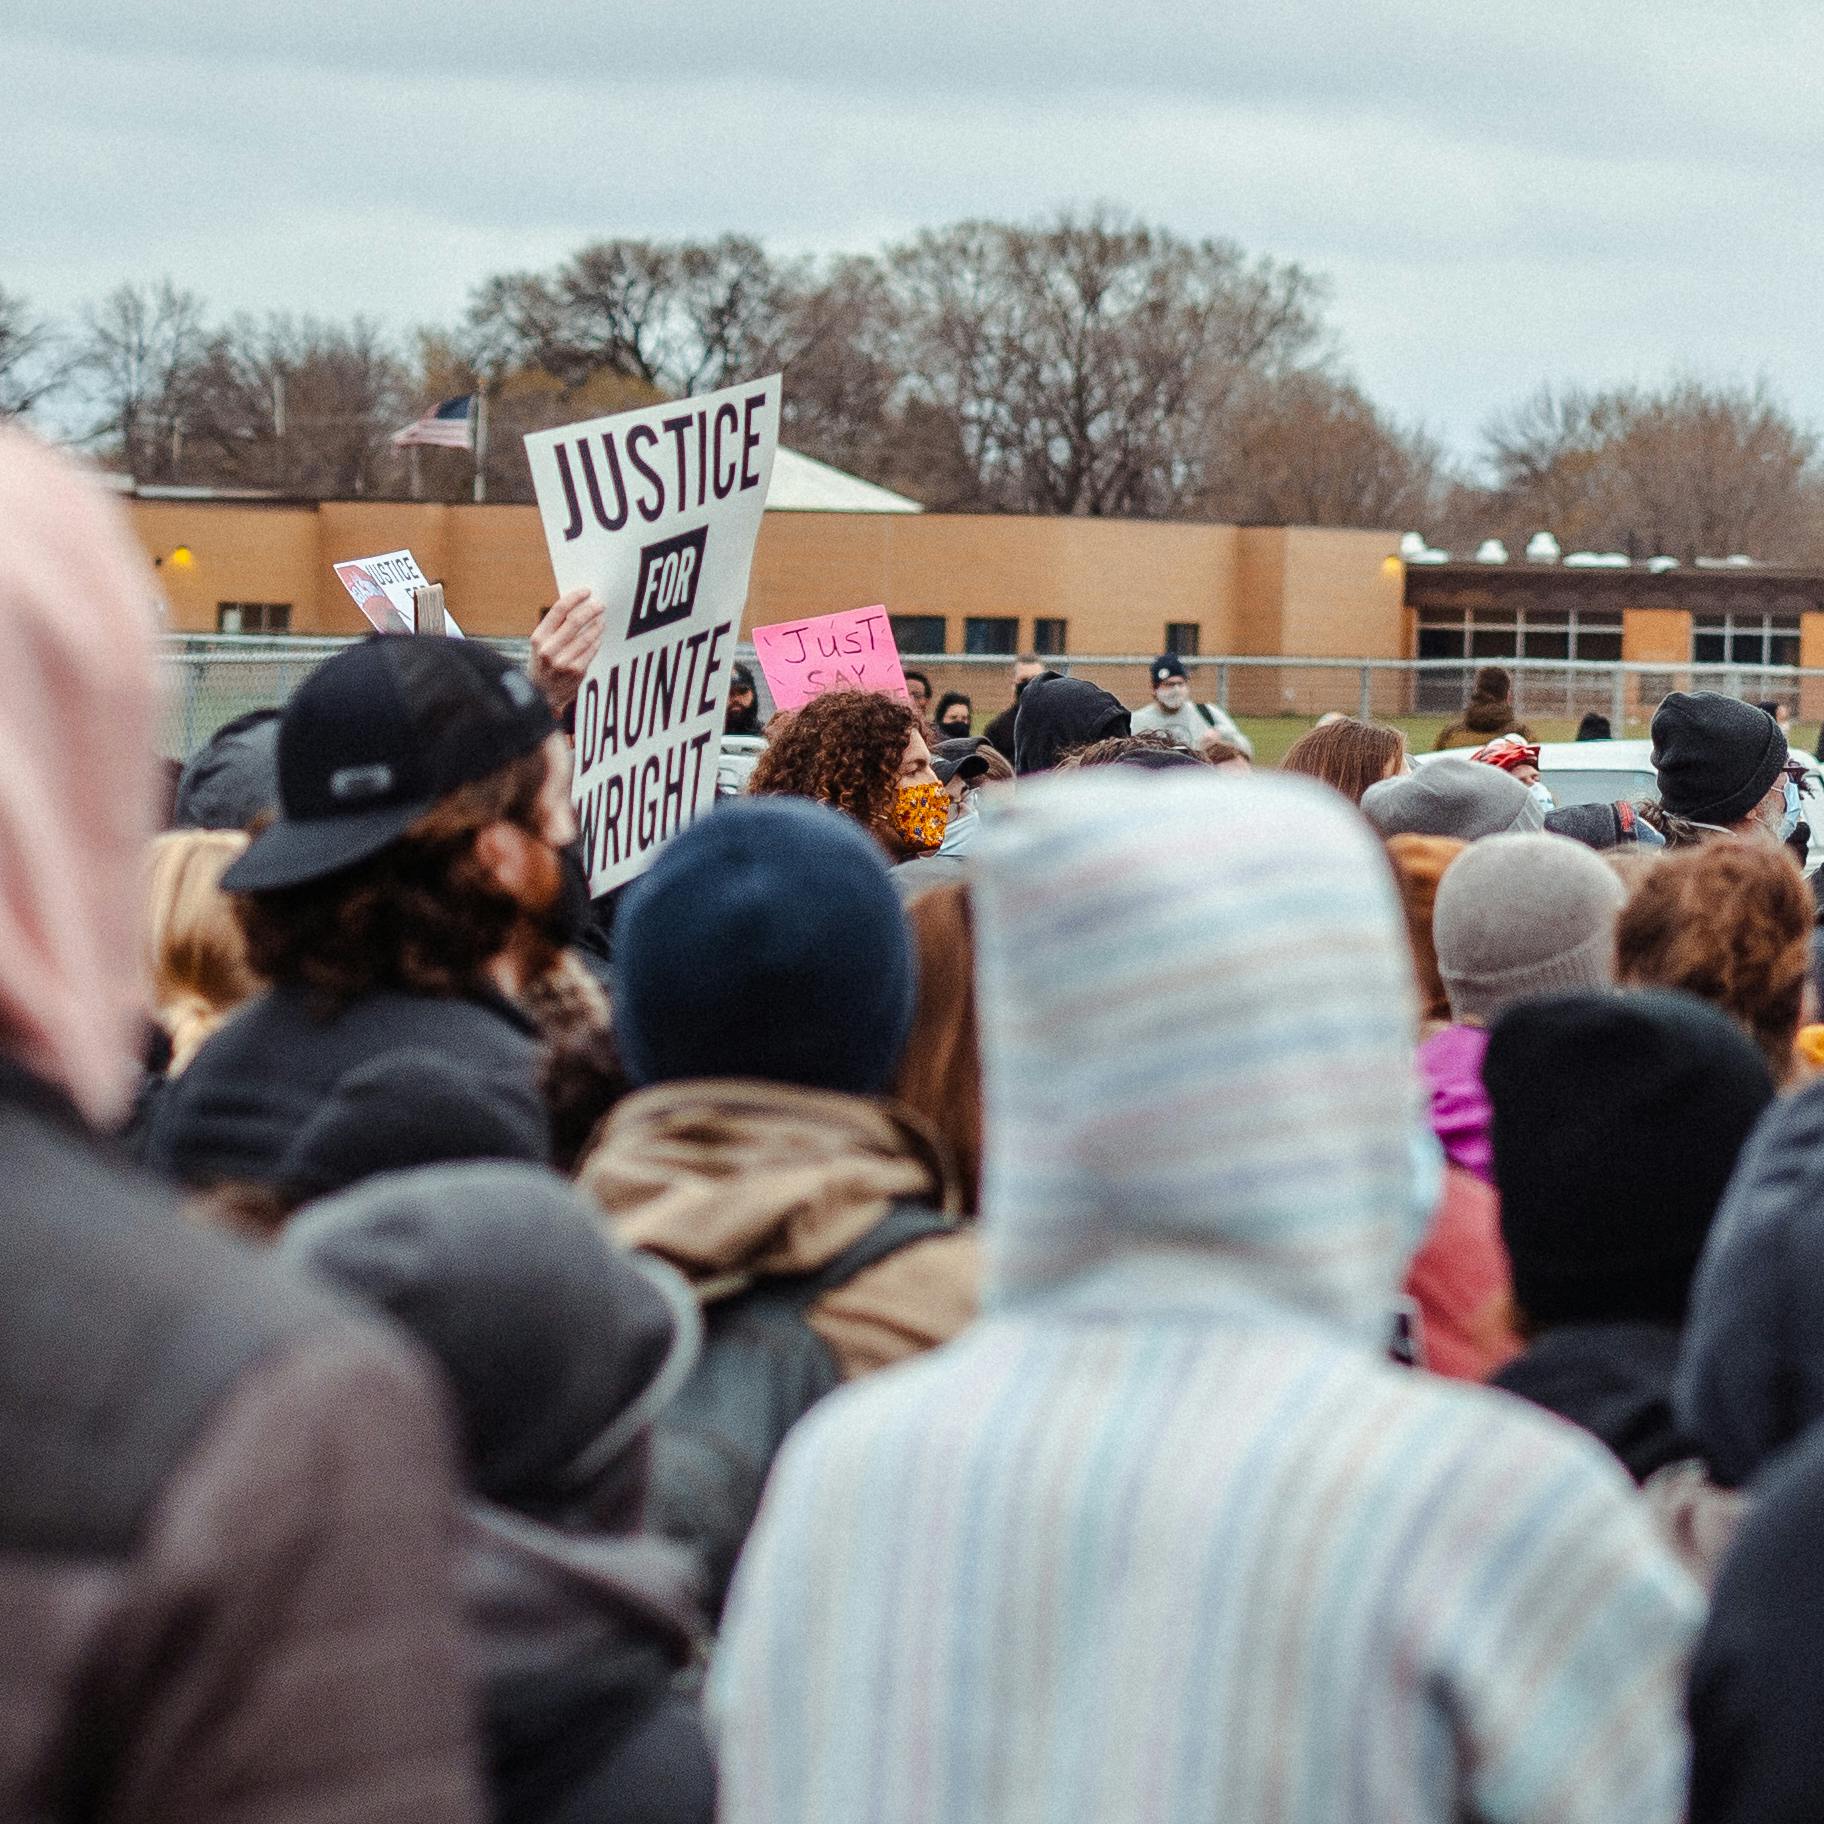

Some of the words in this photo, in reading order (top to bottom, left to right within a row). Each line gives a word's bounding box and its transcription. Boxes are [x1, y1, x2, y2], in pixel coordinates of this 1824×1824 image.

[554, 392, 766, 542] JUSTICE
[639, 546, 697, 619] FOR
[580, 621, 732, 776] DAUNTE
[577, 730, 713, 882] WRIGHT
